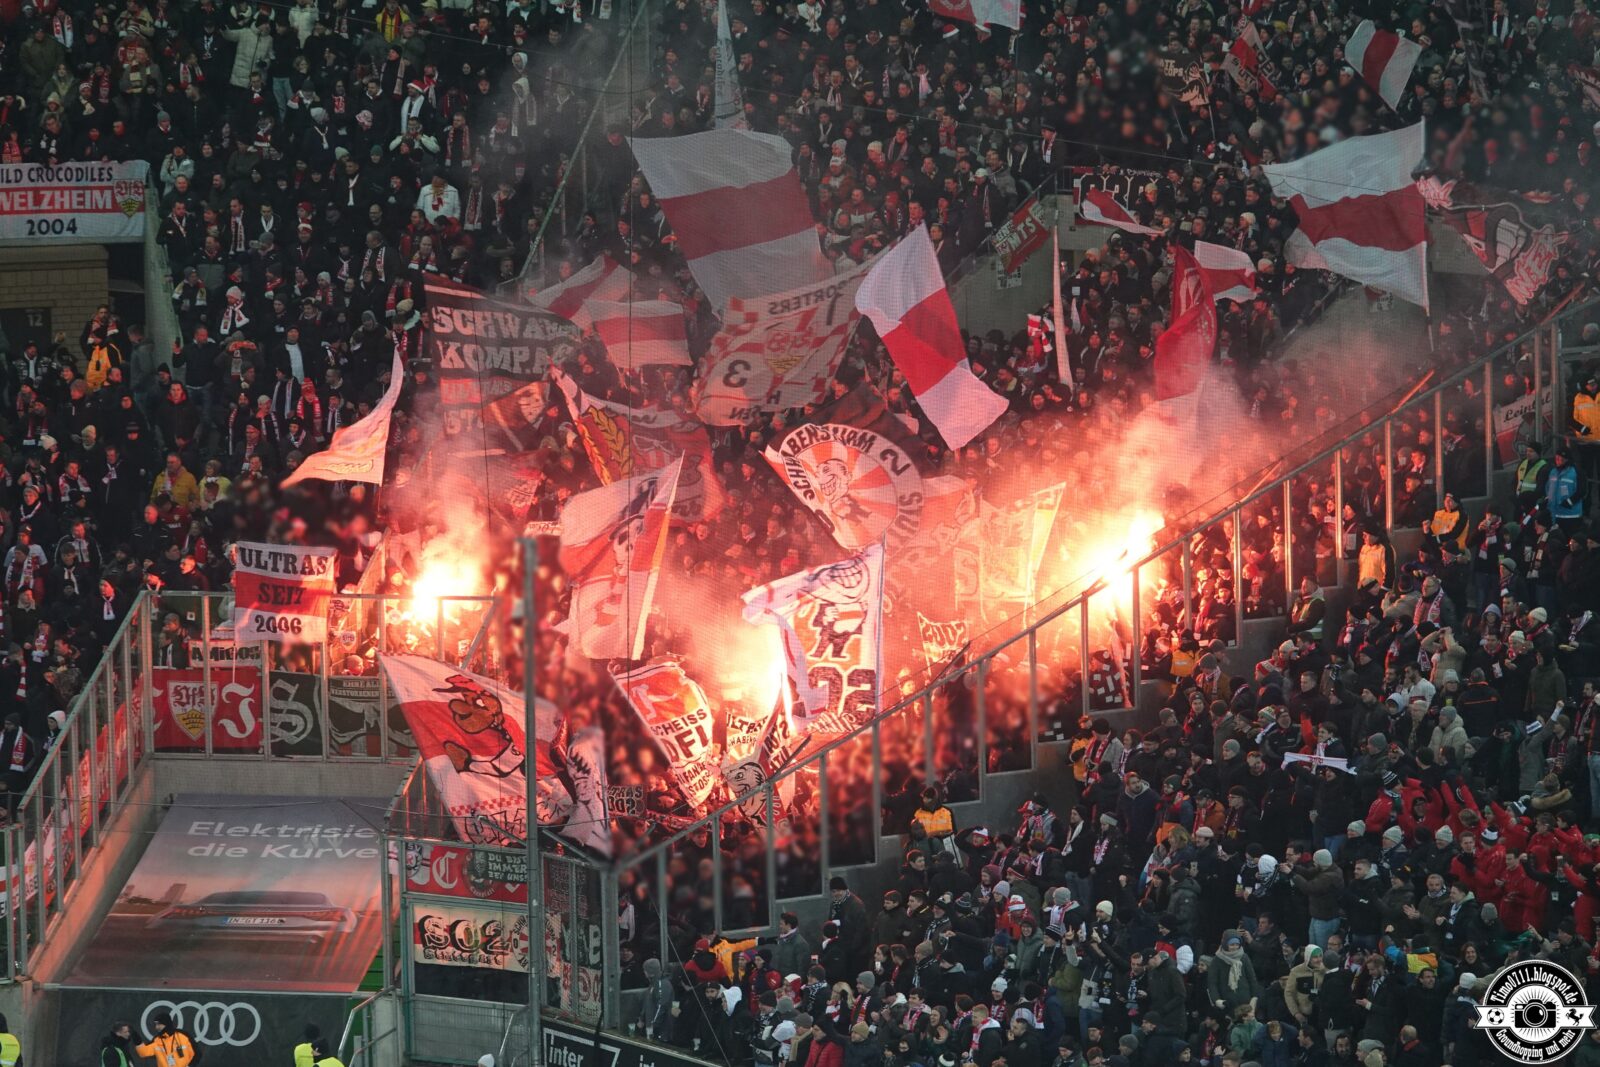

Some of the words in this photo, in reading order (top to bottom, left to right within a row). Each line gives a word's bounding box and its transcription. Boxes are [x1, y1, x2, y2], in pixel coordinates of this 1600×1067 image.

[27, 166, 113, 183] CROCODILES
[26, 217, 78, 236] 2004
[26, 313, 44, 328] 12
[239, 546, 329, 577] ULTRAS
[257, 582, 307, 605] SEIT
[254, 614, 302, 635] 2006
[187, 843, 244, 858] die
[260, 844, 379, 859] Kurve
[488, 853, 501, 861] DU
[488, 862, 528, 874] IMMER
